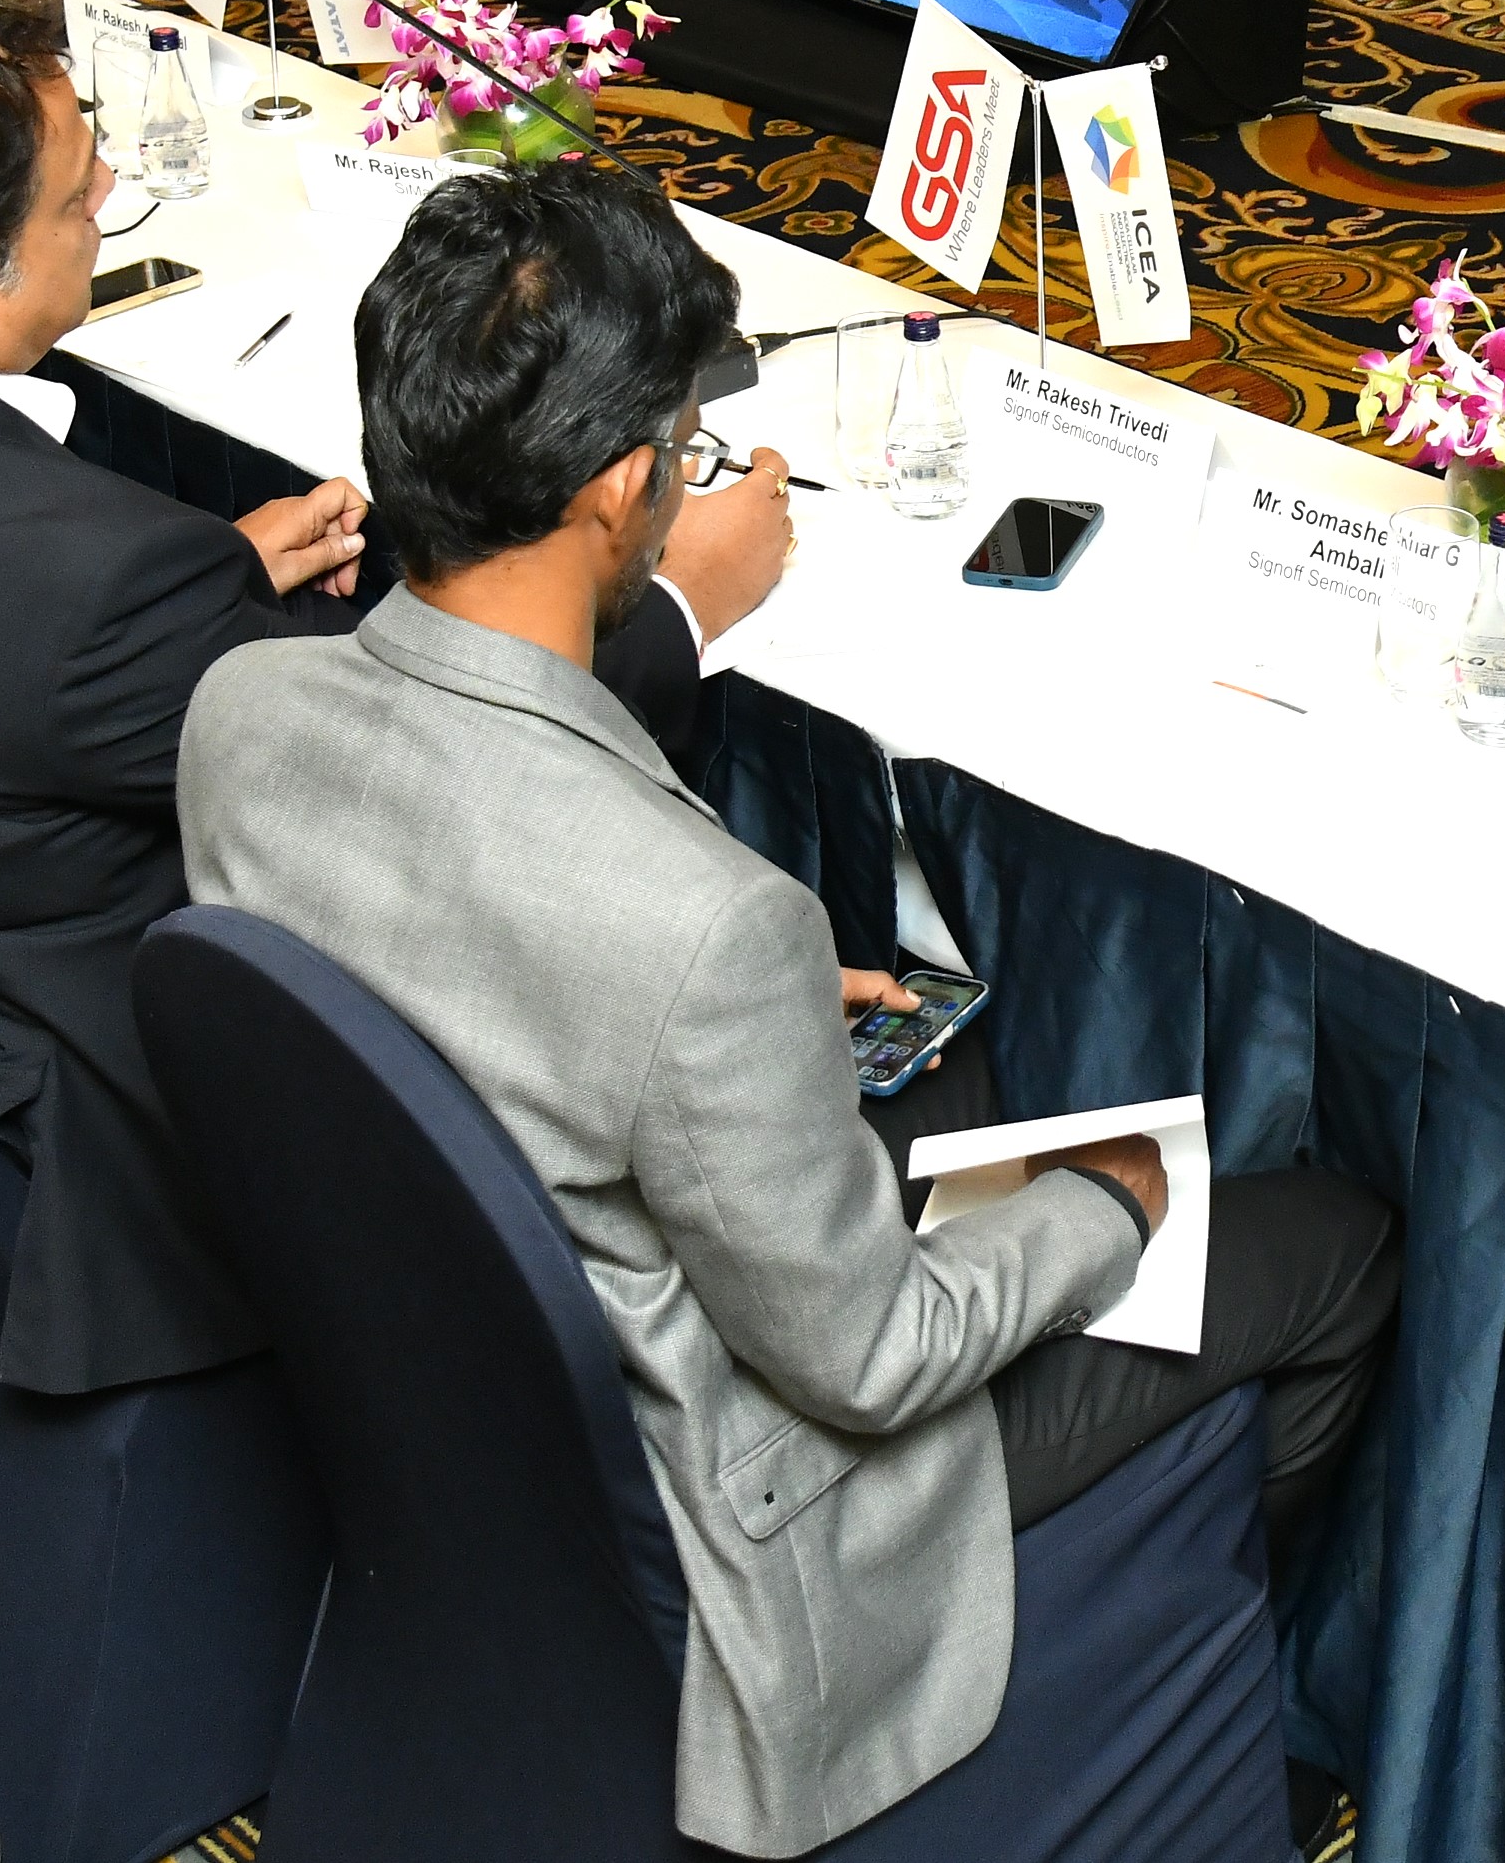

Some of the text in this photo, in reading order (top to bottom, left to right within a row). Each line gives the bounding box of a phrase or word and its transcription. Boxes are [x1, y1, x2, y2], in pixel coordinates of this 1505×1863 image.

[85, 3, 141, 33] Mr. Rakesh
[335, 154, 434, 181] Mr. Rajesh
[901, 69, 987, 241] GSA
[944, 77, 1001, 263] Where Leaders Meet
[1131, 209, 1161, 304] ICEA
[1003, 397, 1159, 467] Signoff Semiconductors
[1006, 368, 1170, 443] Mr. Rakesh Trivedi
[1253, 488, 1282, 515] Mr.
[1445, 544, 1460, 566] G
[1248, 550, 1305, 581] Signoff
